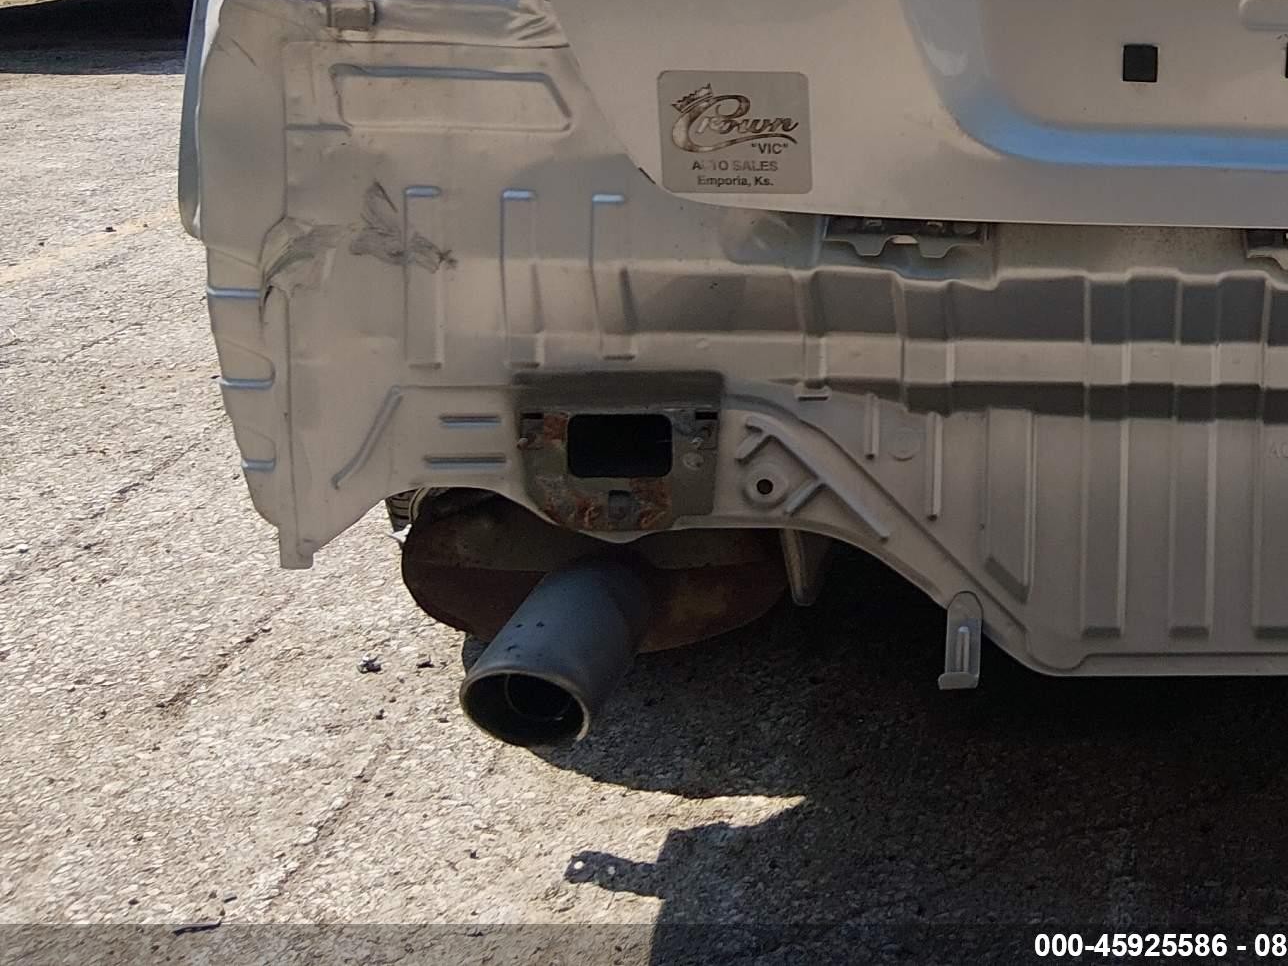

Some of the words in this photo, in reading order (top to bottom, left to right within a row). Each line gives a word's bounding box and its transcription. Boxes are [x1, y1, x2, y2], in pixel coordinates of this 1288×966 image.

[672, 94, 799, 153] Crown
[733, 160, 778, 172] SALES
[697, 175, 752, 187] Emporia,
[754, 175, 774, 186] Ks.
